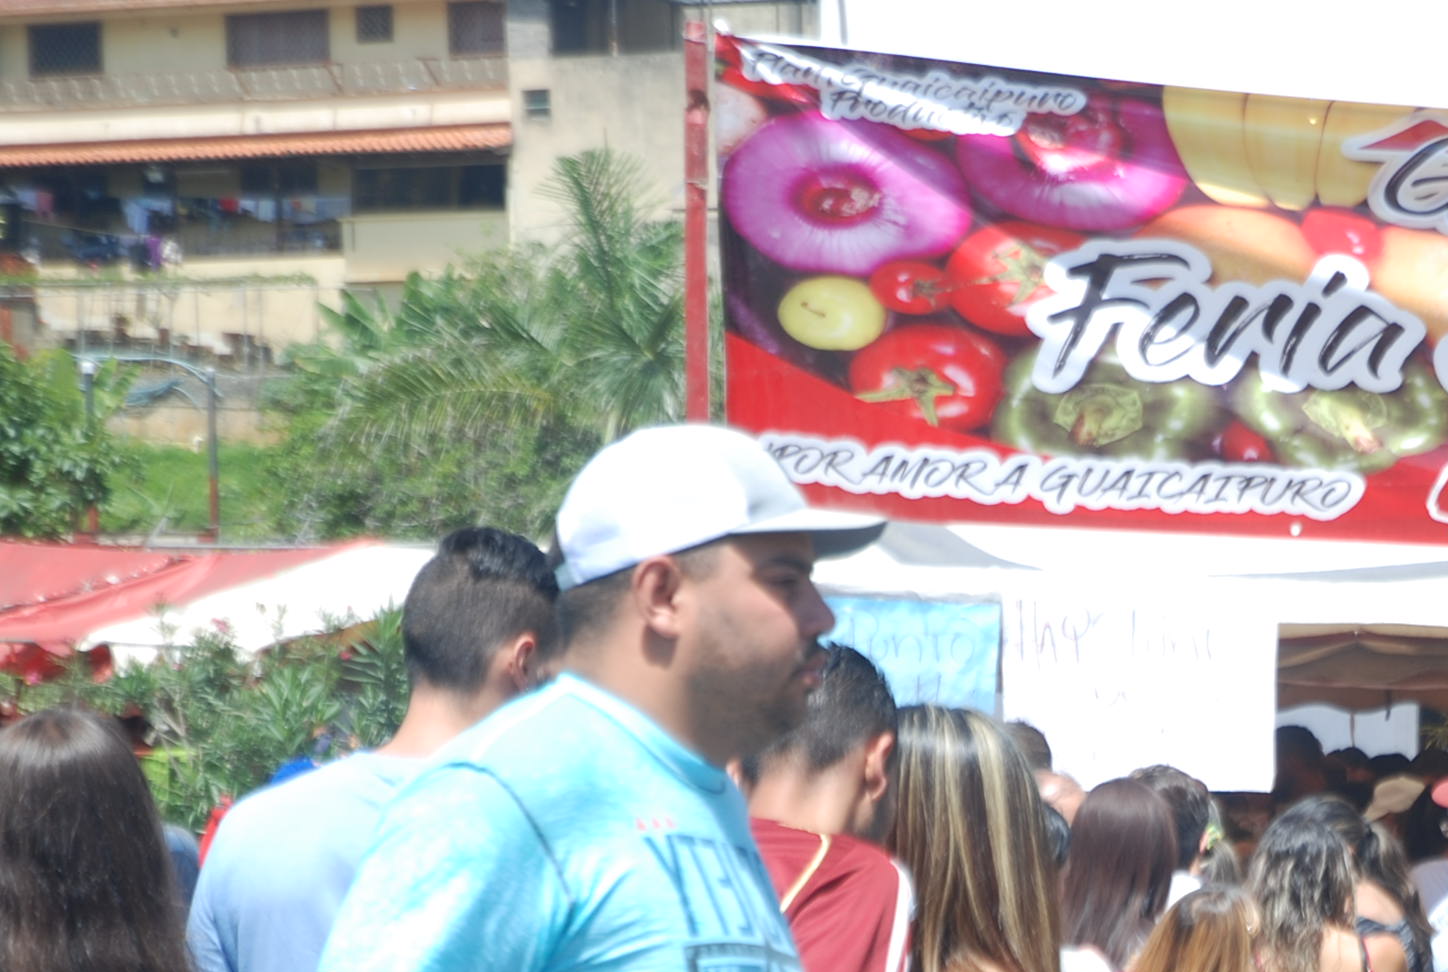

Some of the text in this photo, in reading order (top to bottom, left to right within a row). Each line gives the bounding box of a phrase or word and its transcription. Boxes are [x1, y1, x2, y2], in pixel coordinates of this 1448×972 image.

[1047, 252, 1404, 381] Feria
[861, 454, 989, 496] AMOR
[993, 461, 1022, 495] A
[1040, 466, 1354, 504] GUAICAIPURO
